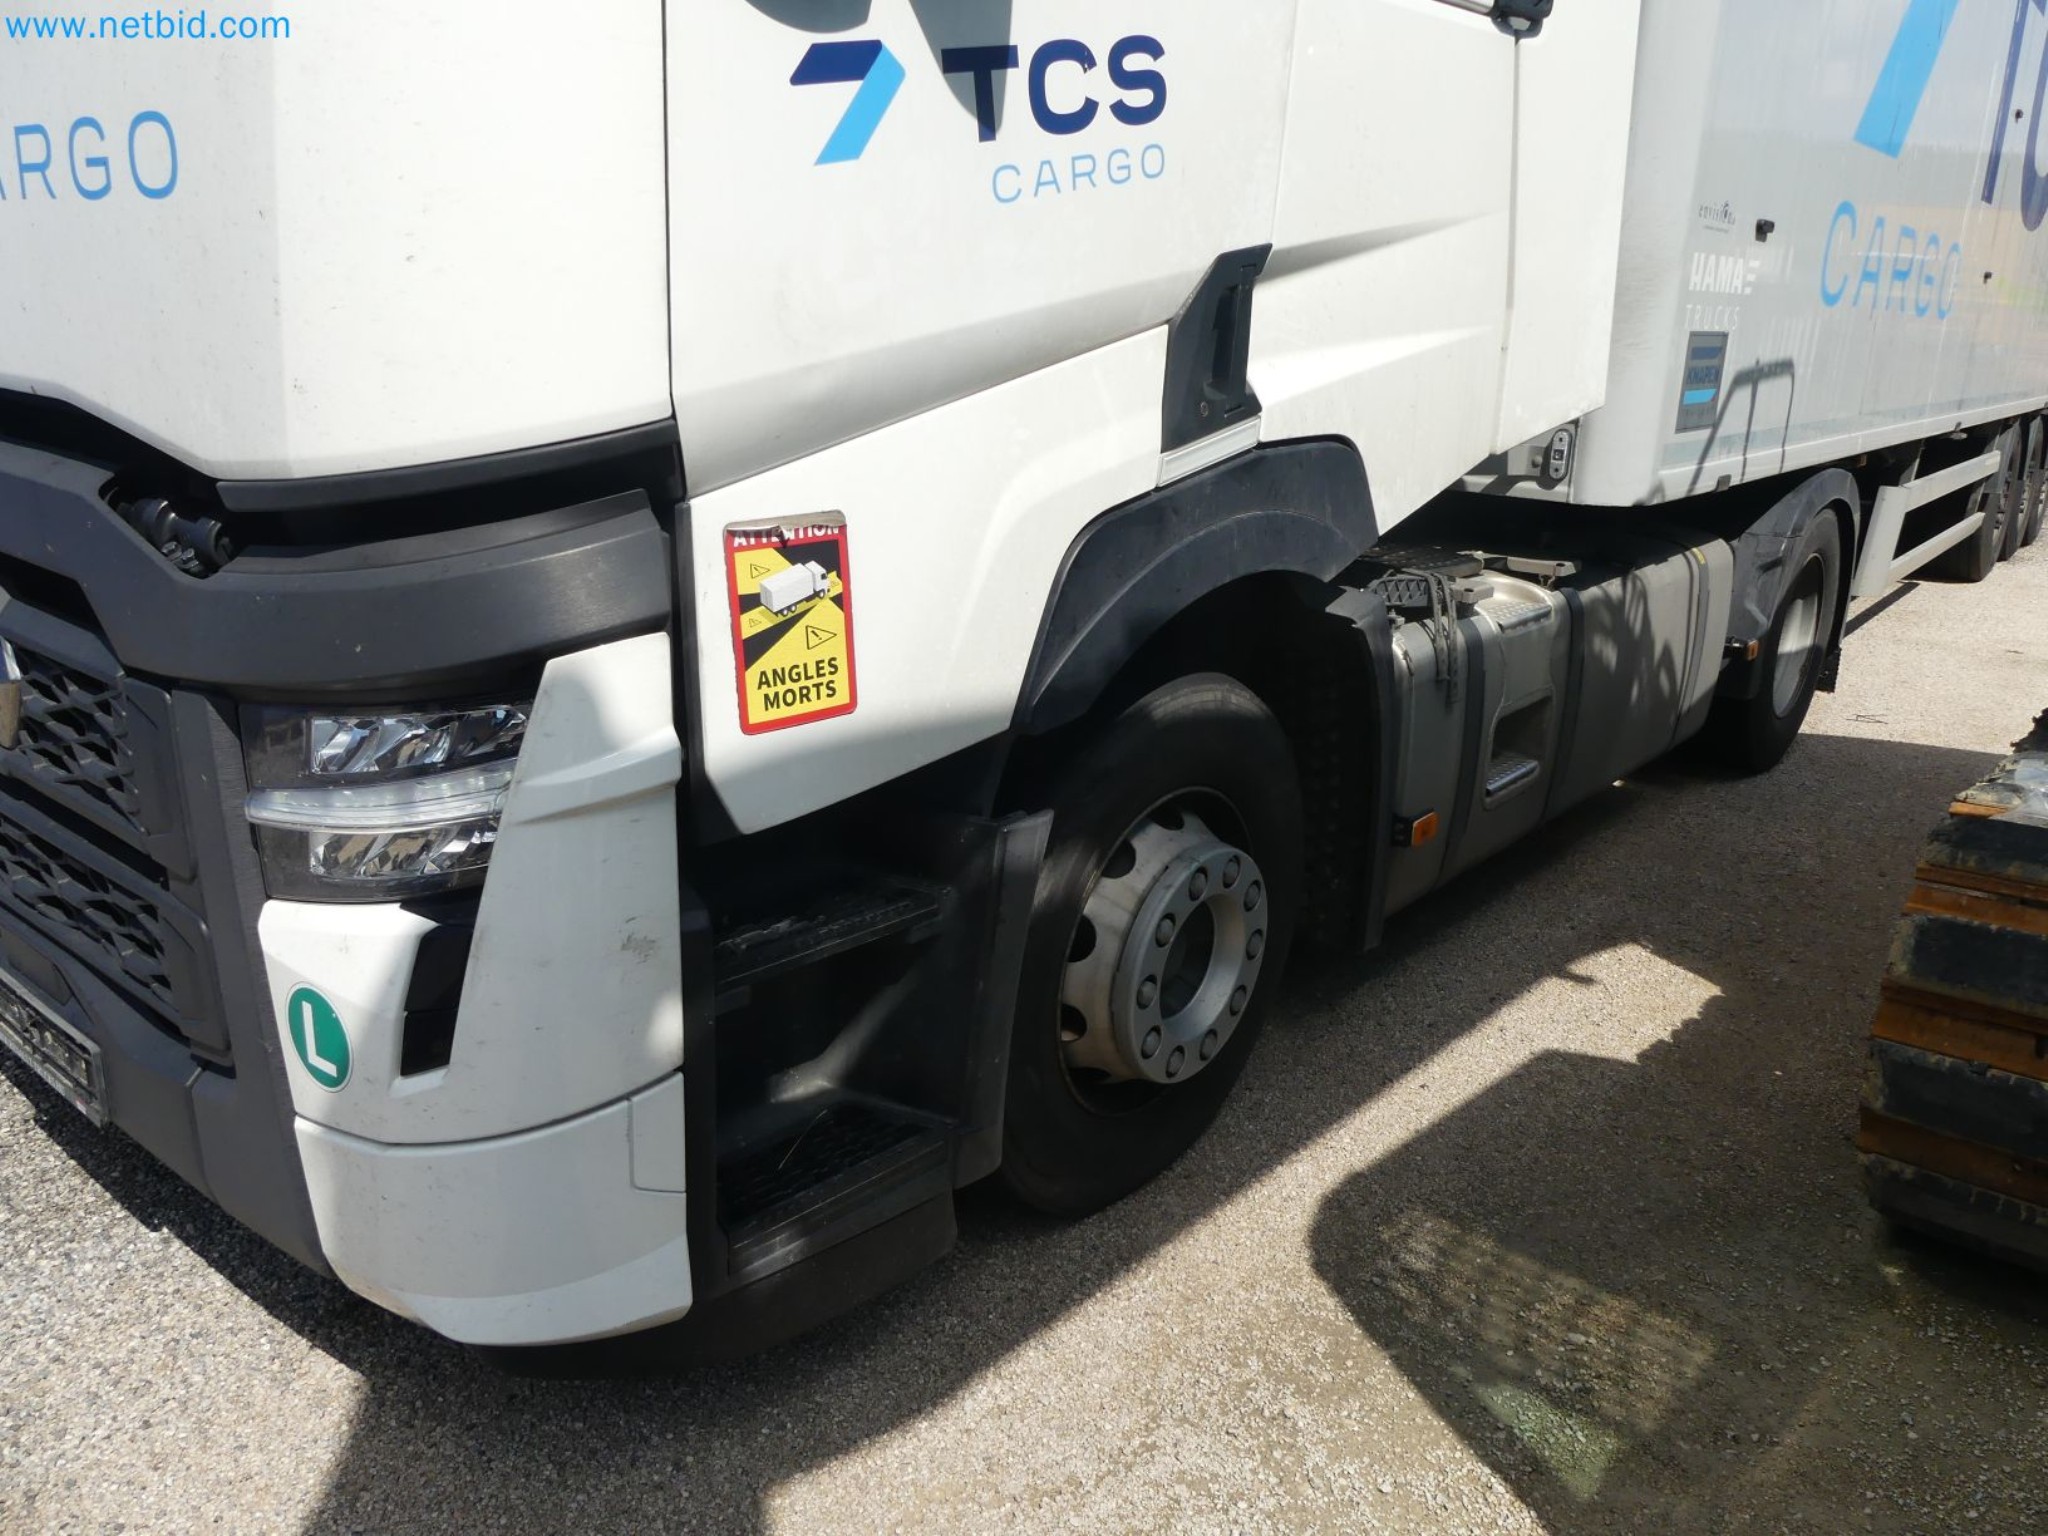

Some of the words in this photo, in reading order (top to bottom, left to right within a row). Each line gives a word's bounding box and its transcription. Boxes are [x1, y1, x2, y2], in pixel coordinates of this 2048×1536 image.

[941, 35, 1167, 142] TCS
[0, 110, 178, 200] RGO
[991, 144, 1165, 203] CARGO
[1820, 200, 1961, 320] CARGO
[757, 657, 839, 690] ANGLES
[763, 680, 837, 711] MORTS
[302, 1001, 337, 1077] L
